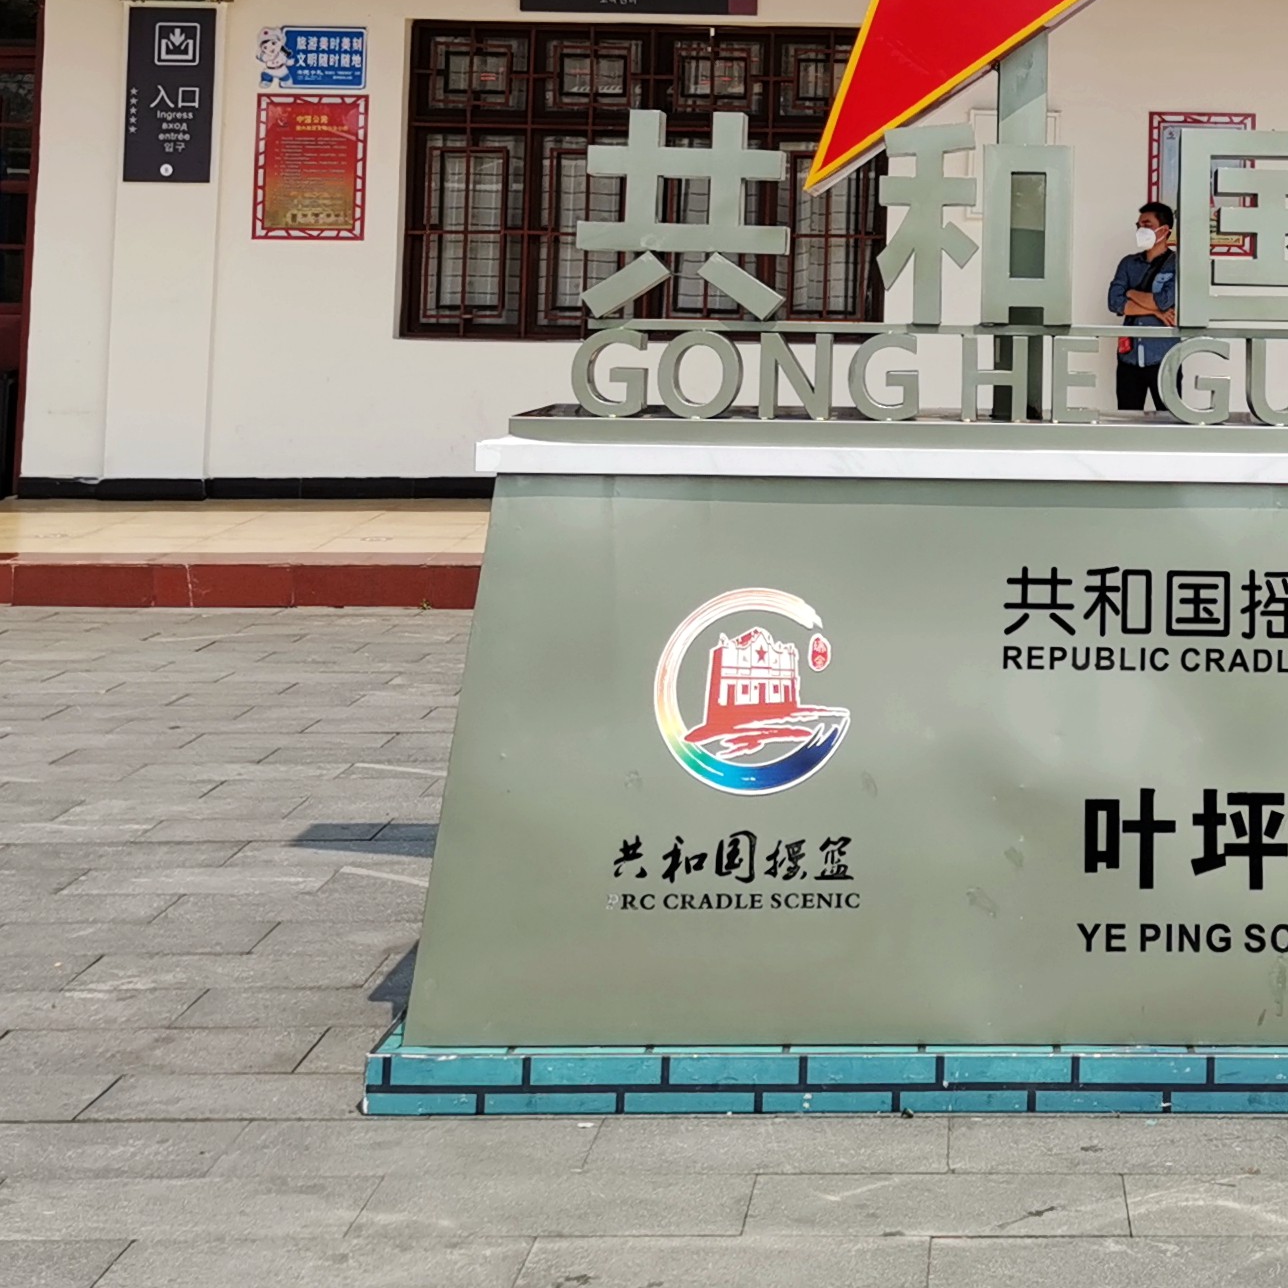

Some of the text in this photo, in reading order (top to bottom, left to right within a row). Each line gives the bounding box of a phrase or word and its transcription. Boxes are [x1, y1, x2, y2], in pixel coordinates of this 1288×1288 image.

[296, 53, 362, 68] 文明随时随地
[149, 85, 200, 109] 入口
[156, 110, 194, 121] Ingress
[158, 132, 191, 141] entrée
[161, 122, 188, 131] вход
[571, 328, 919, 423] GONG
[962, 334, 1103, 424] HE
[1002, 645, 1171, 672] REPUBLIC
[613, 829, 855, 884] 共和国摇篮
[663, 893, 764, 910] CRADLE
[770, 892, 861, 910] SCENIC
[1076, 922, 1127, 953] YE
[1139, 922, 1233, 954] PING
